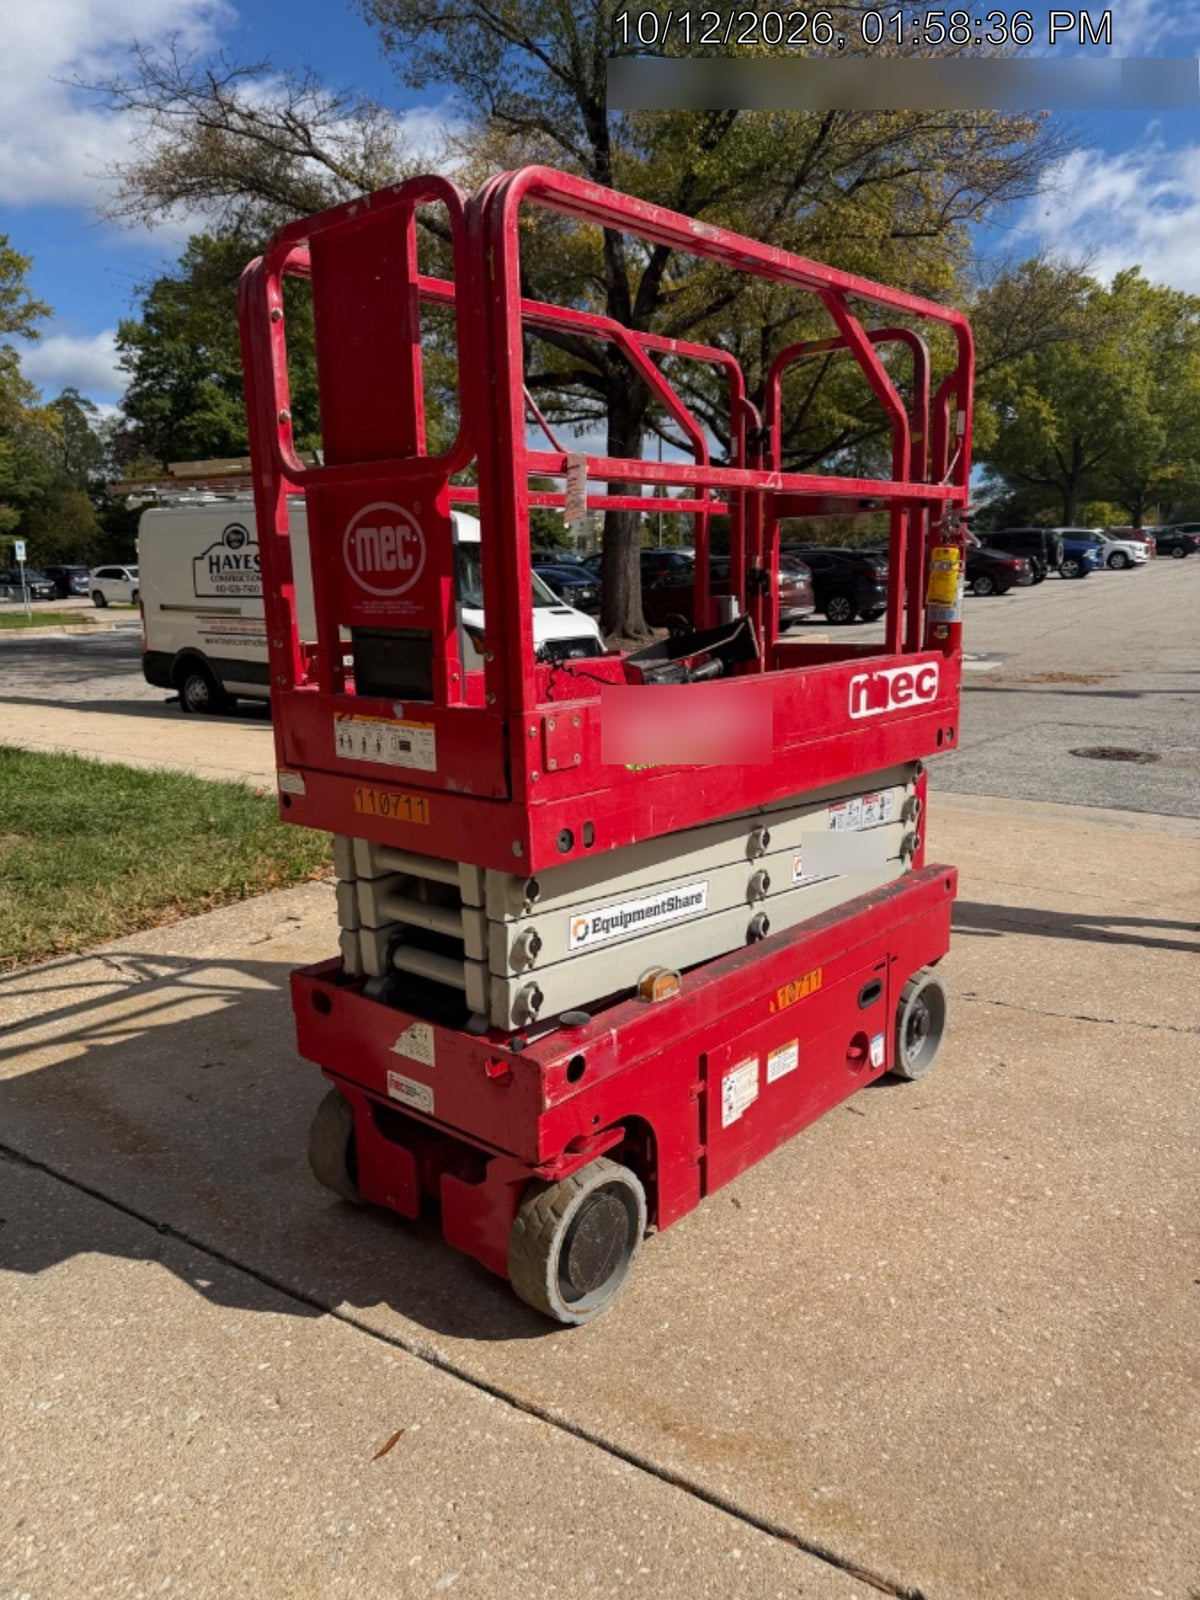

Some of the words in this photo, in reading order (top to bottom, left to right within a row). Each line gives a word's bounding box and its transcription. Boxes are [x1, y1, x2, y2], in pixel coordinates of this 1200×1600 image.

[208, 553, 262, 574] HAYES
[355, 787, 427, 825] 110711
[590, 892, 703, 935] EquipmentShare
